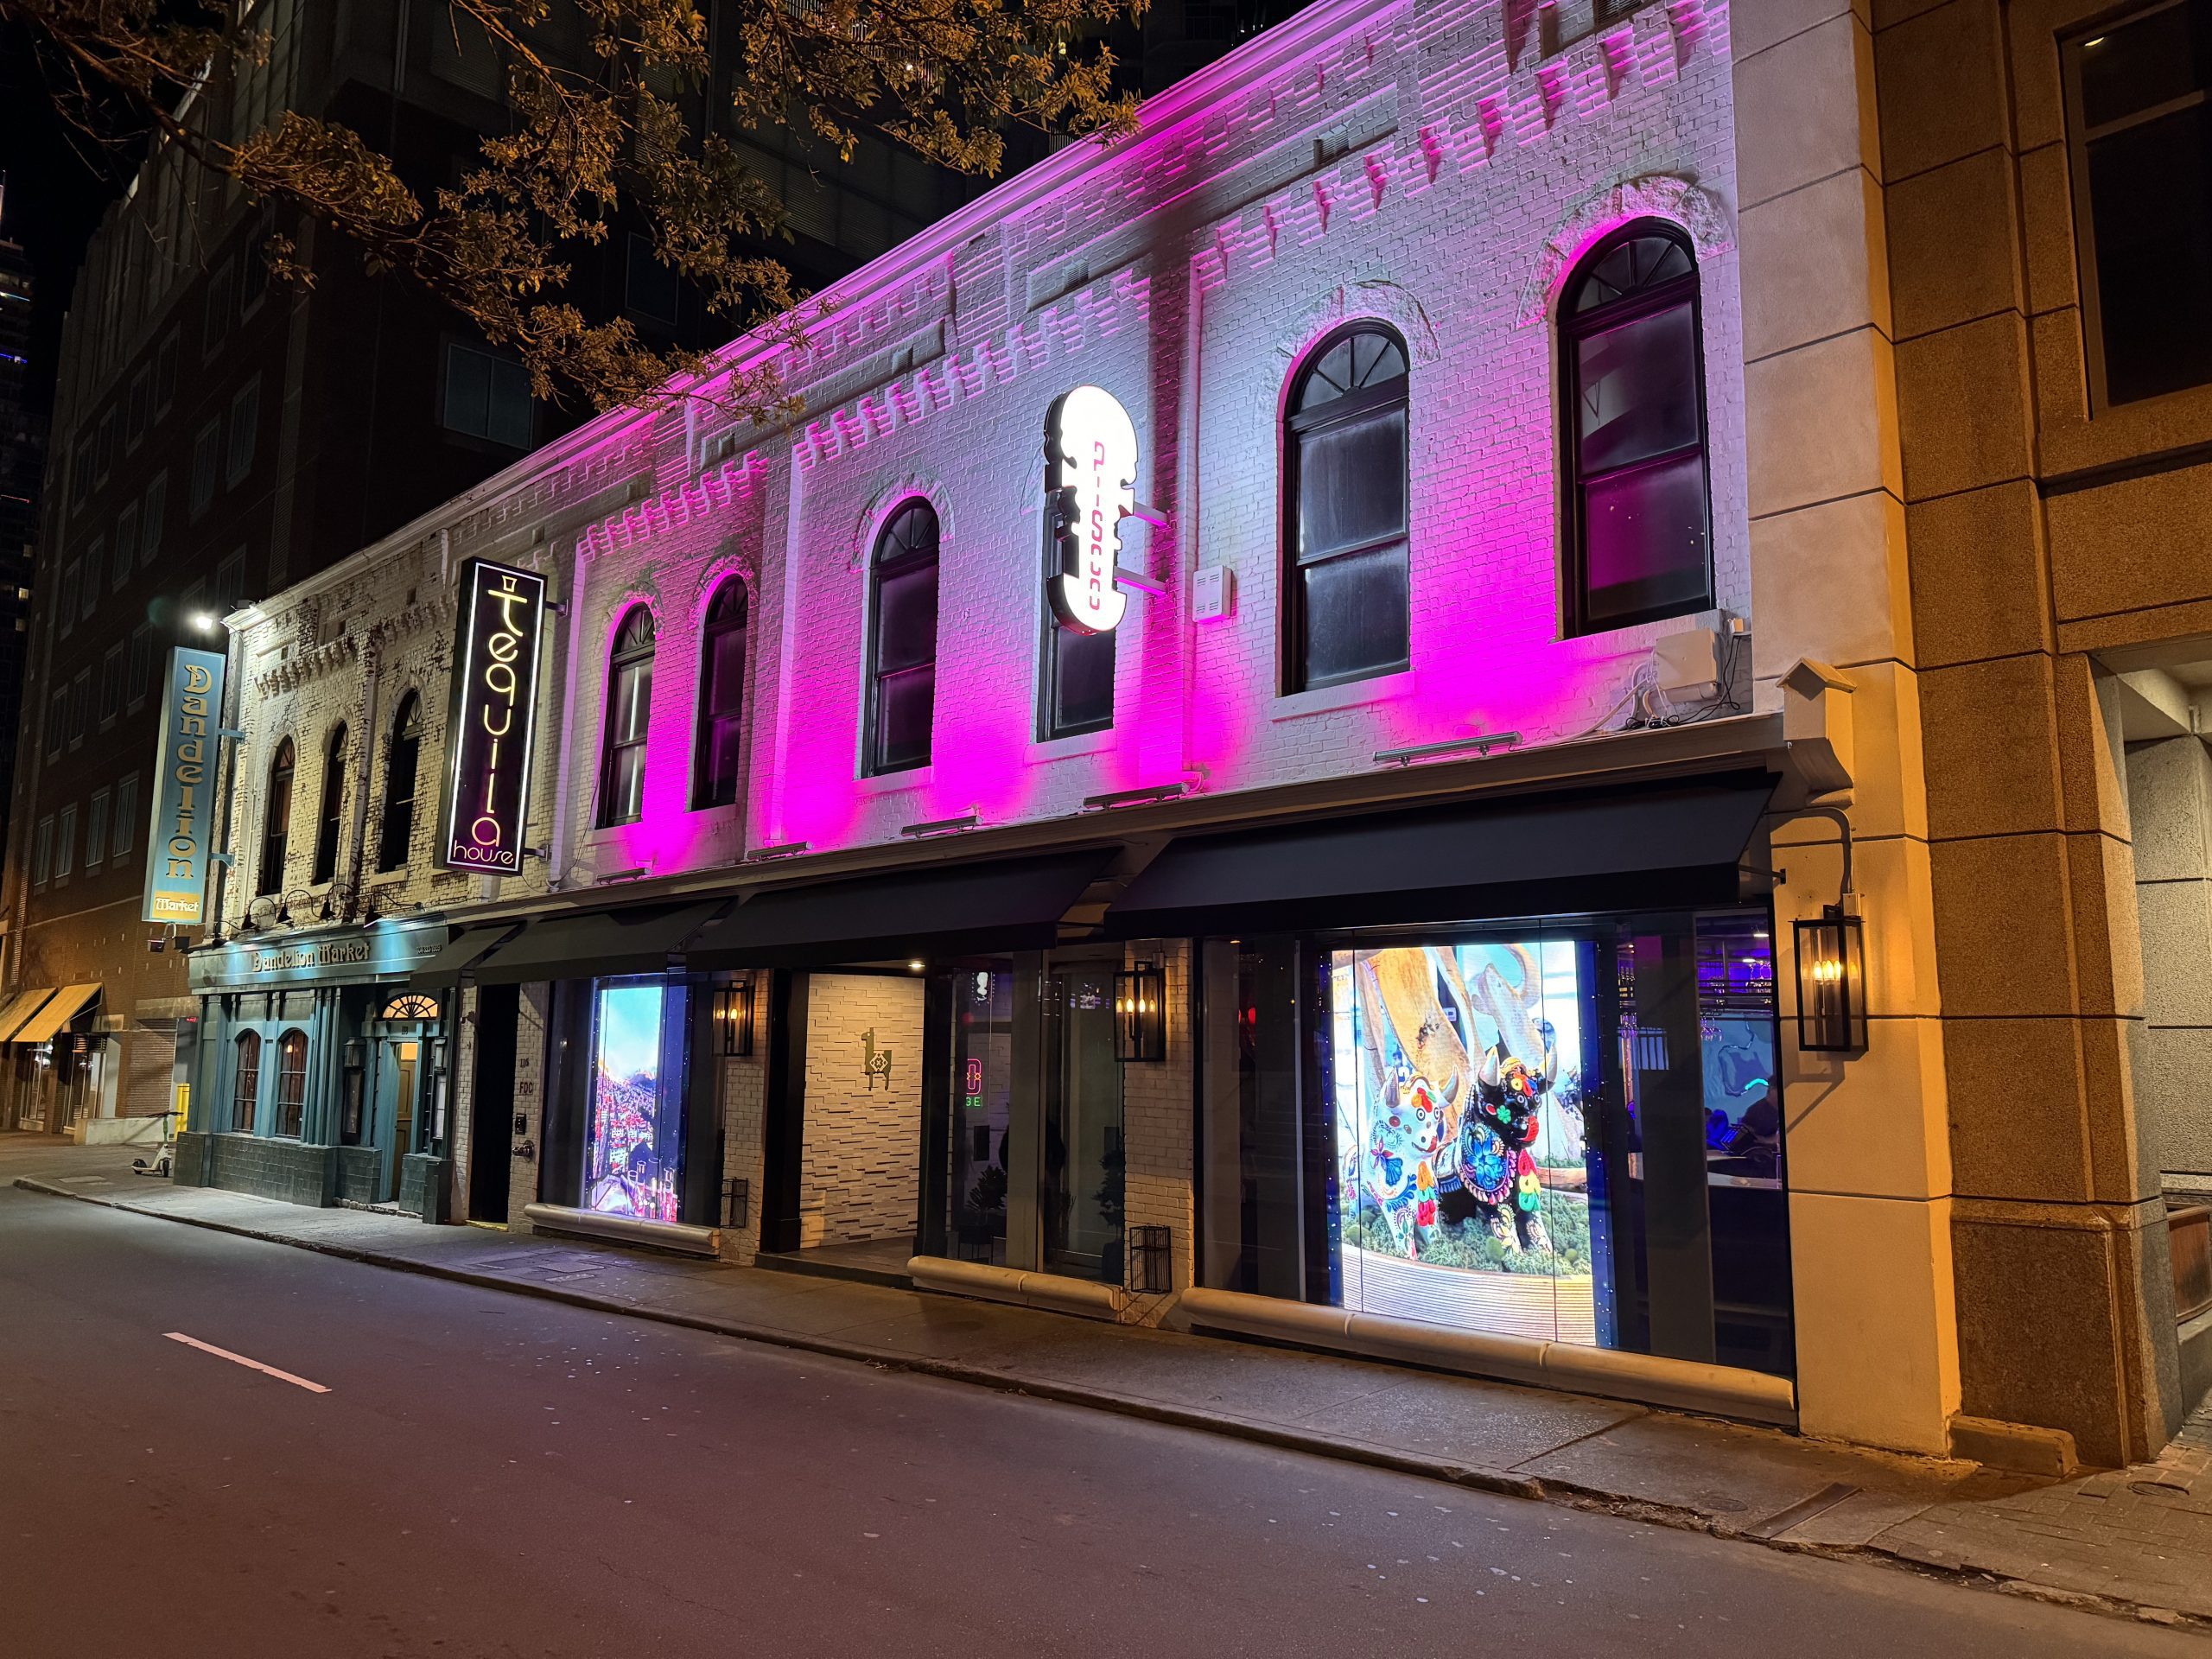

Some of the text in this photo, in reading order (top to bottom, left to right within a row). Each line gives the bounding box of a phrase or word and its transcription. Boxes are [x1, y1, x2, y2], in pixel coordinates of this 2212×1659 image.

[165, 664, 213, 880] Dandelion
[453, 839, 514, 865] house
[156, 897, 199, 913] Market
[251, 942, 371, 972] Dandelion Market
[519, 1082, 533, 1094] FDC
